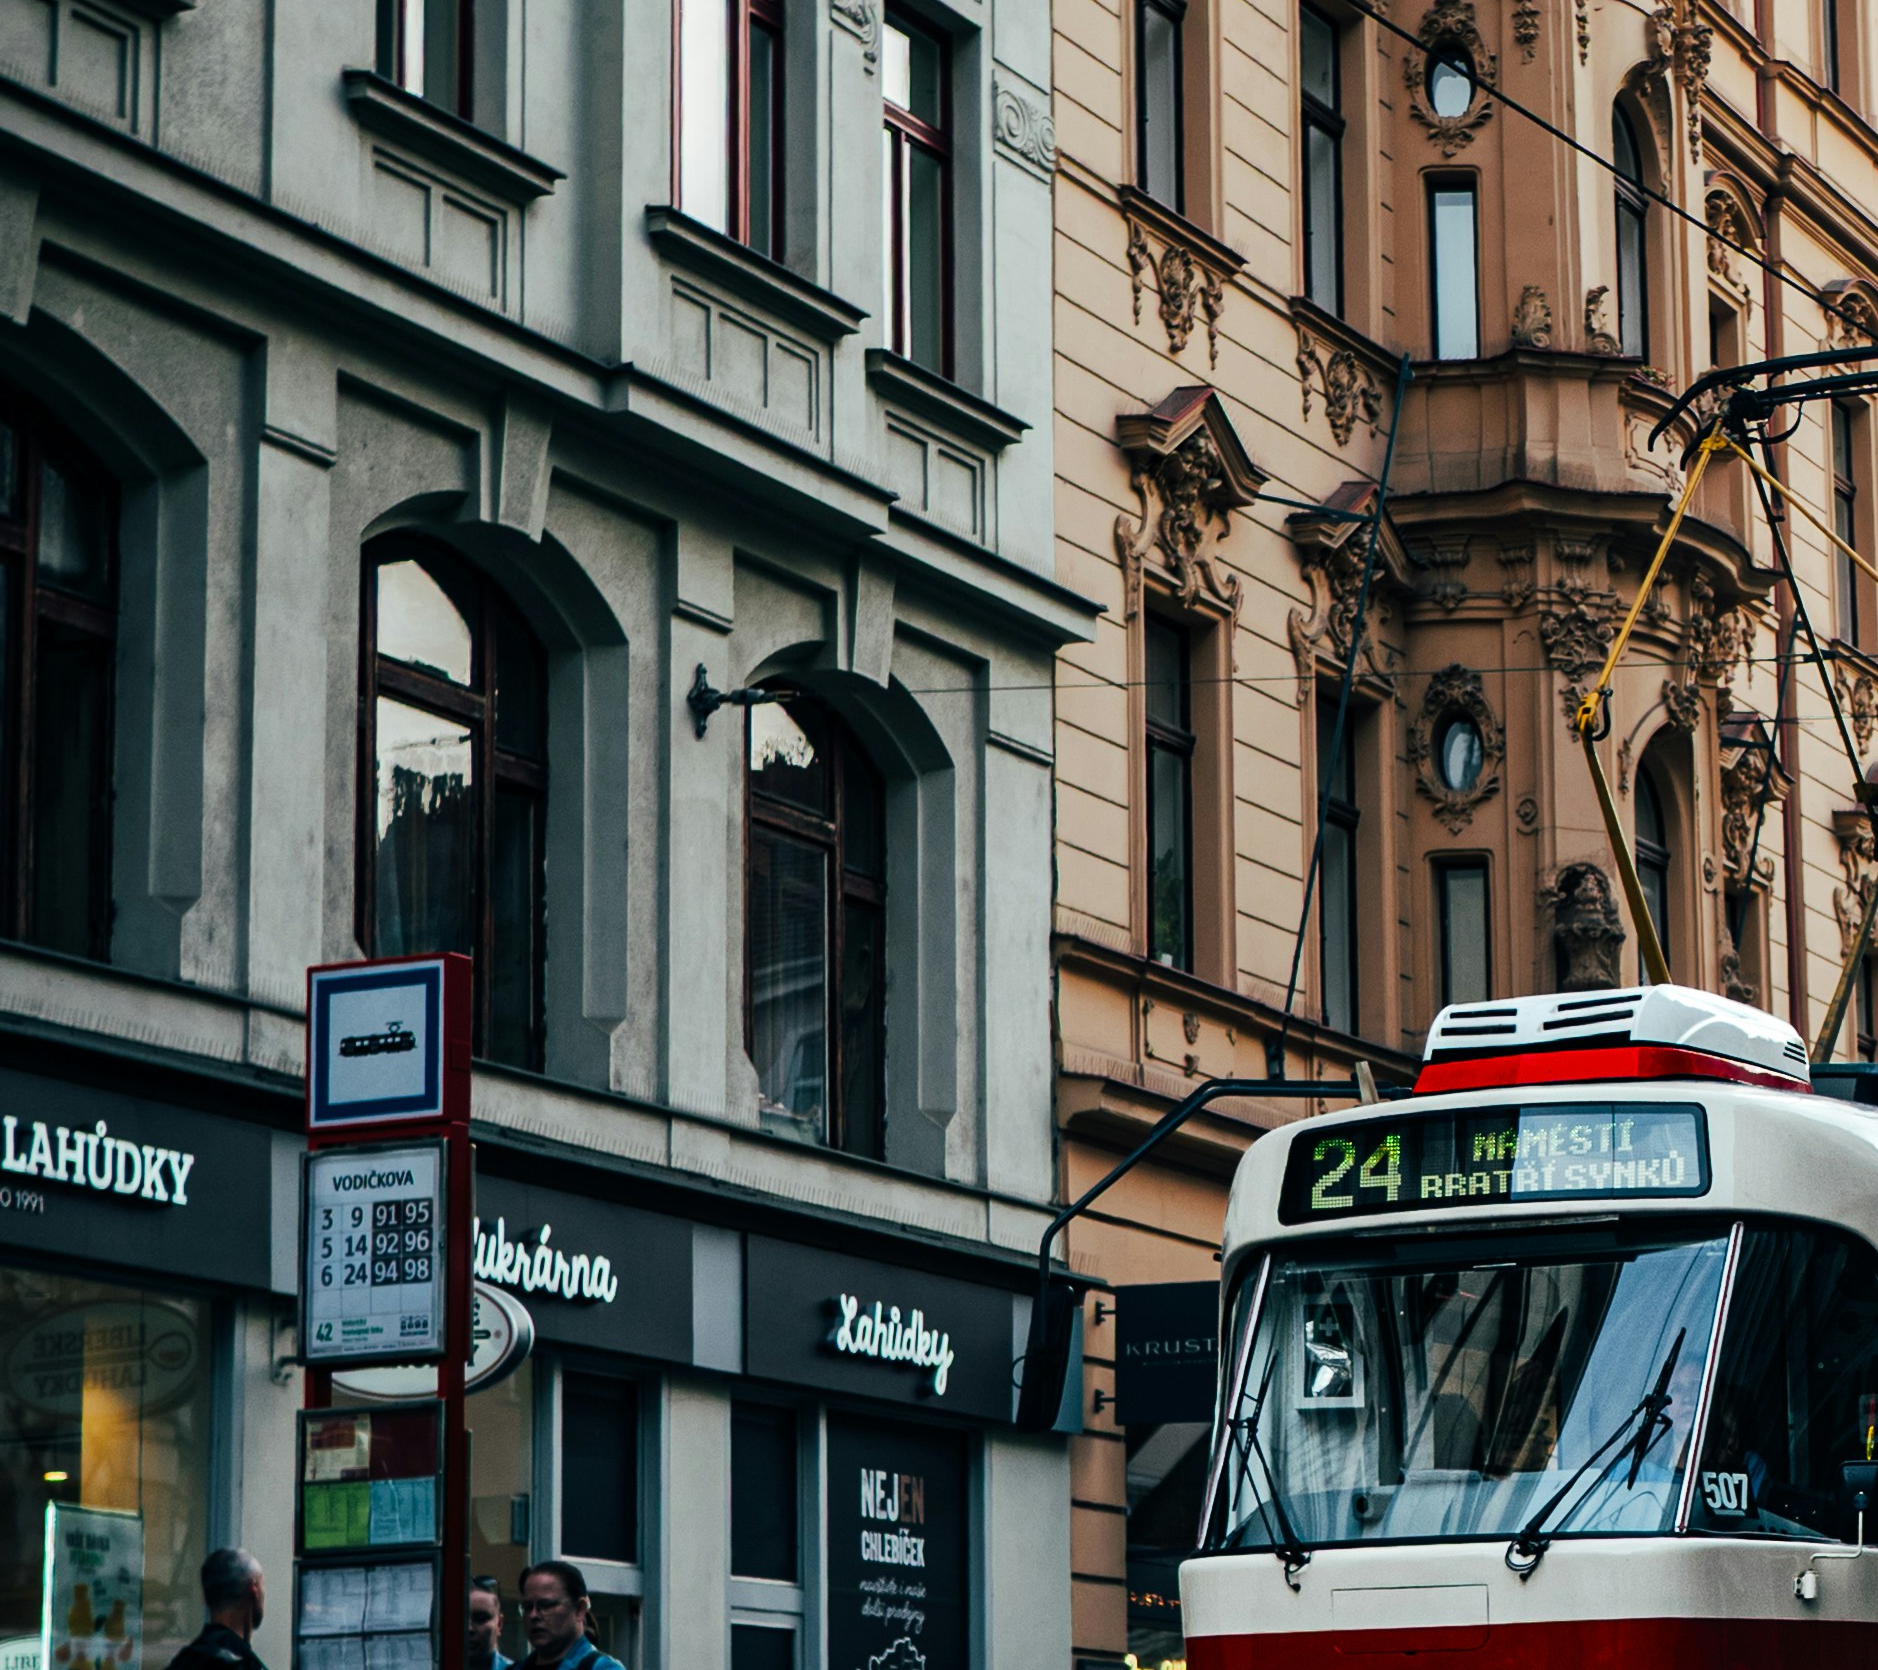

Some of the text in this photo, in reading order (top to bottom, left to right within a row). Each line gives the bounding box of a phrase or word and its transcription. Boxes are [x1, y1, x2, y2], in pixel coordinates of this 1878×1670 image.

[1, 1115, 194, 1205] LAHŮDKY
[1311, 1132, 1402, 1210] 24
[1563, 1149, 1685, 1189] SYNKŮ
[332, 1170, 414, 1191] VODIČKOVA
[15, 1191, 44, 1213] 1991
[322, 1201, 430, 1230] 3 9 91 95
[322, 1230, 429, 1258] 5 14 92 96
[473, 1216, 618, 1303] ukrárna
[321, 1258, 429, 1286] 6 24 94 98
[316, 1323, 332, 1342] 42
[837, 1293, 954, 1395] Lahůdky
[1126, 1337, 1217, 1356] KRUST
[861, 1468, 924, 1525] NEJEN
[1702, 1471, 1748, 1511] 507
[861, 1528, 925, 1567] CHLEBÍČEK
